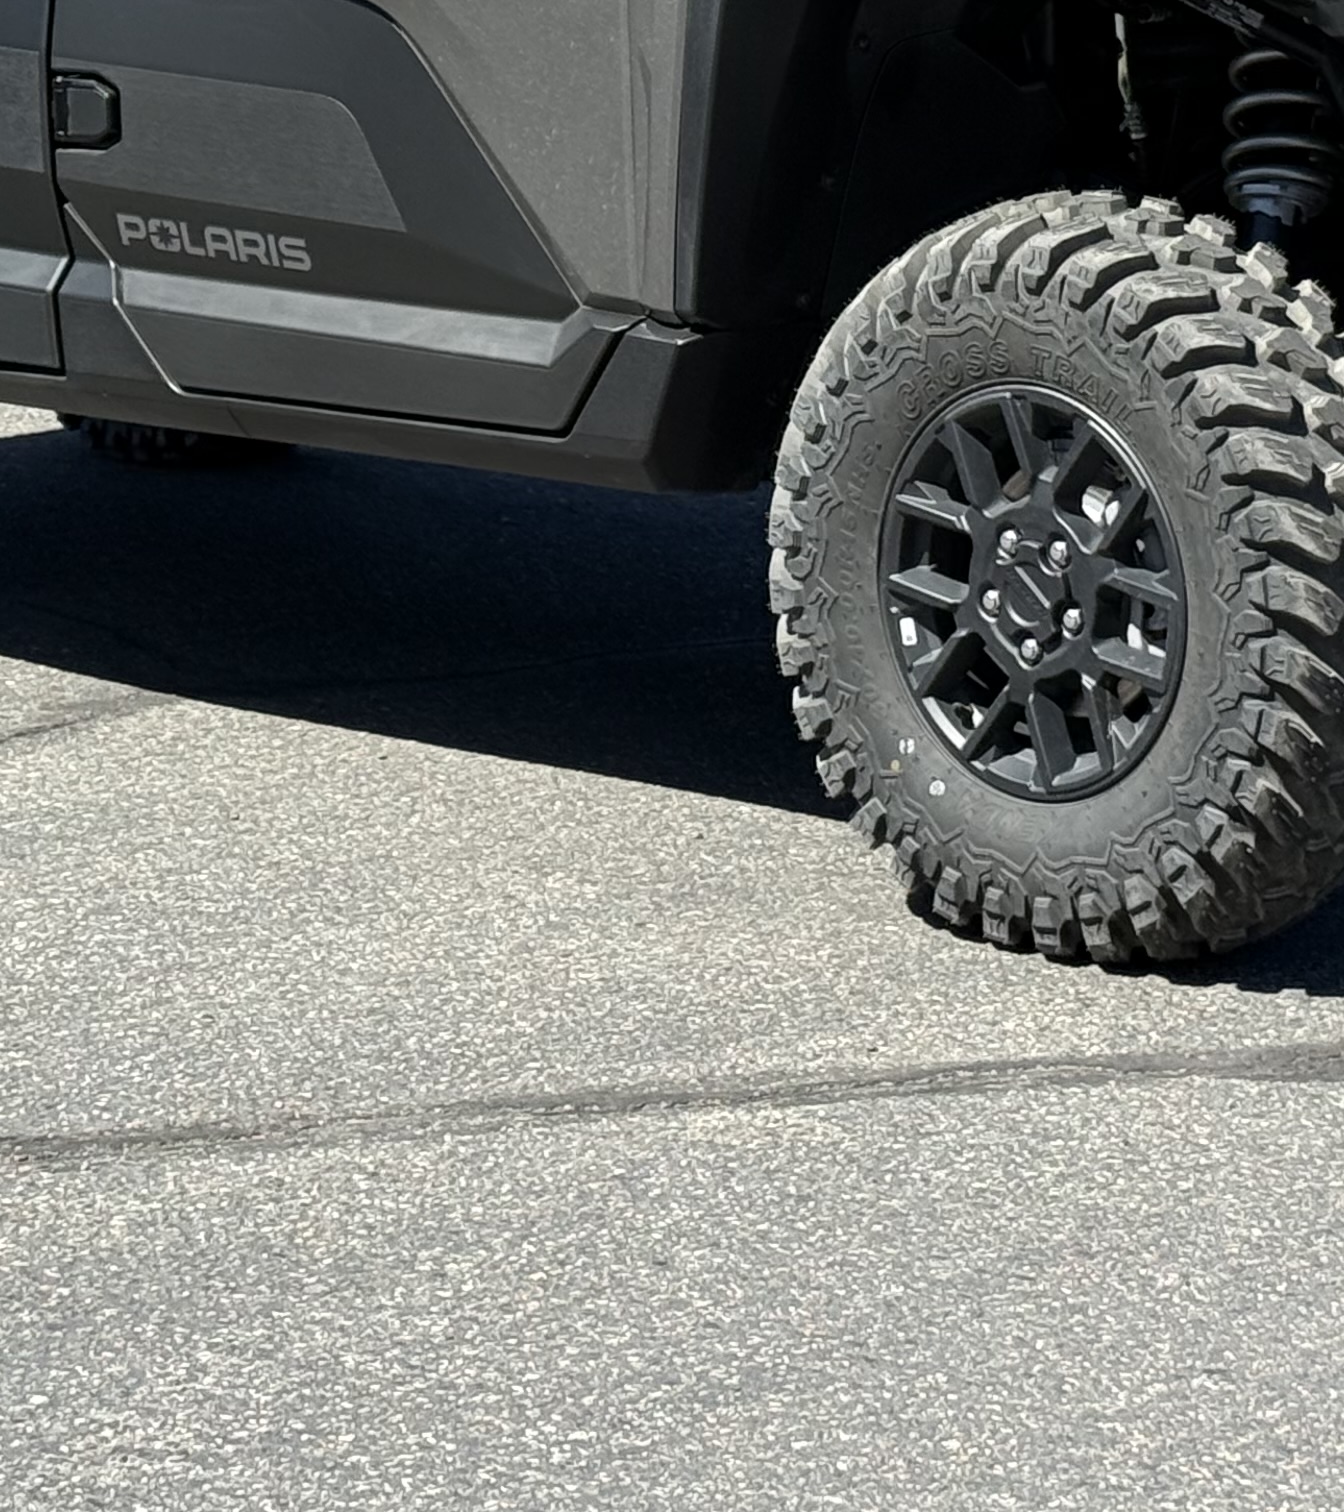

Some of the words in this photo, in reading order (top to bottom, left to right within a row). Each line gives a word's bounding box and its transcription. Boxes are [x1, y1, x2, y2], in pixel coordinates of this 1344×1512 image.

[116, 212, 312, 272] POLARIS
[896, 338, 1011, 420] CROSS
[1030, 344, 1135, 436] TRAIL
